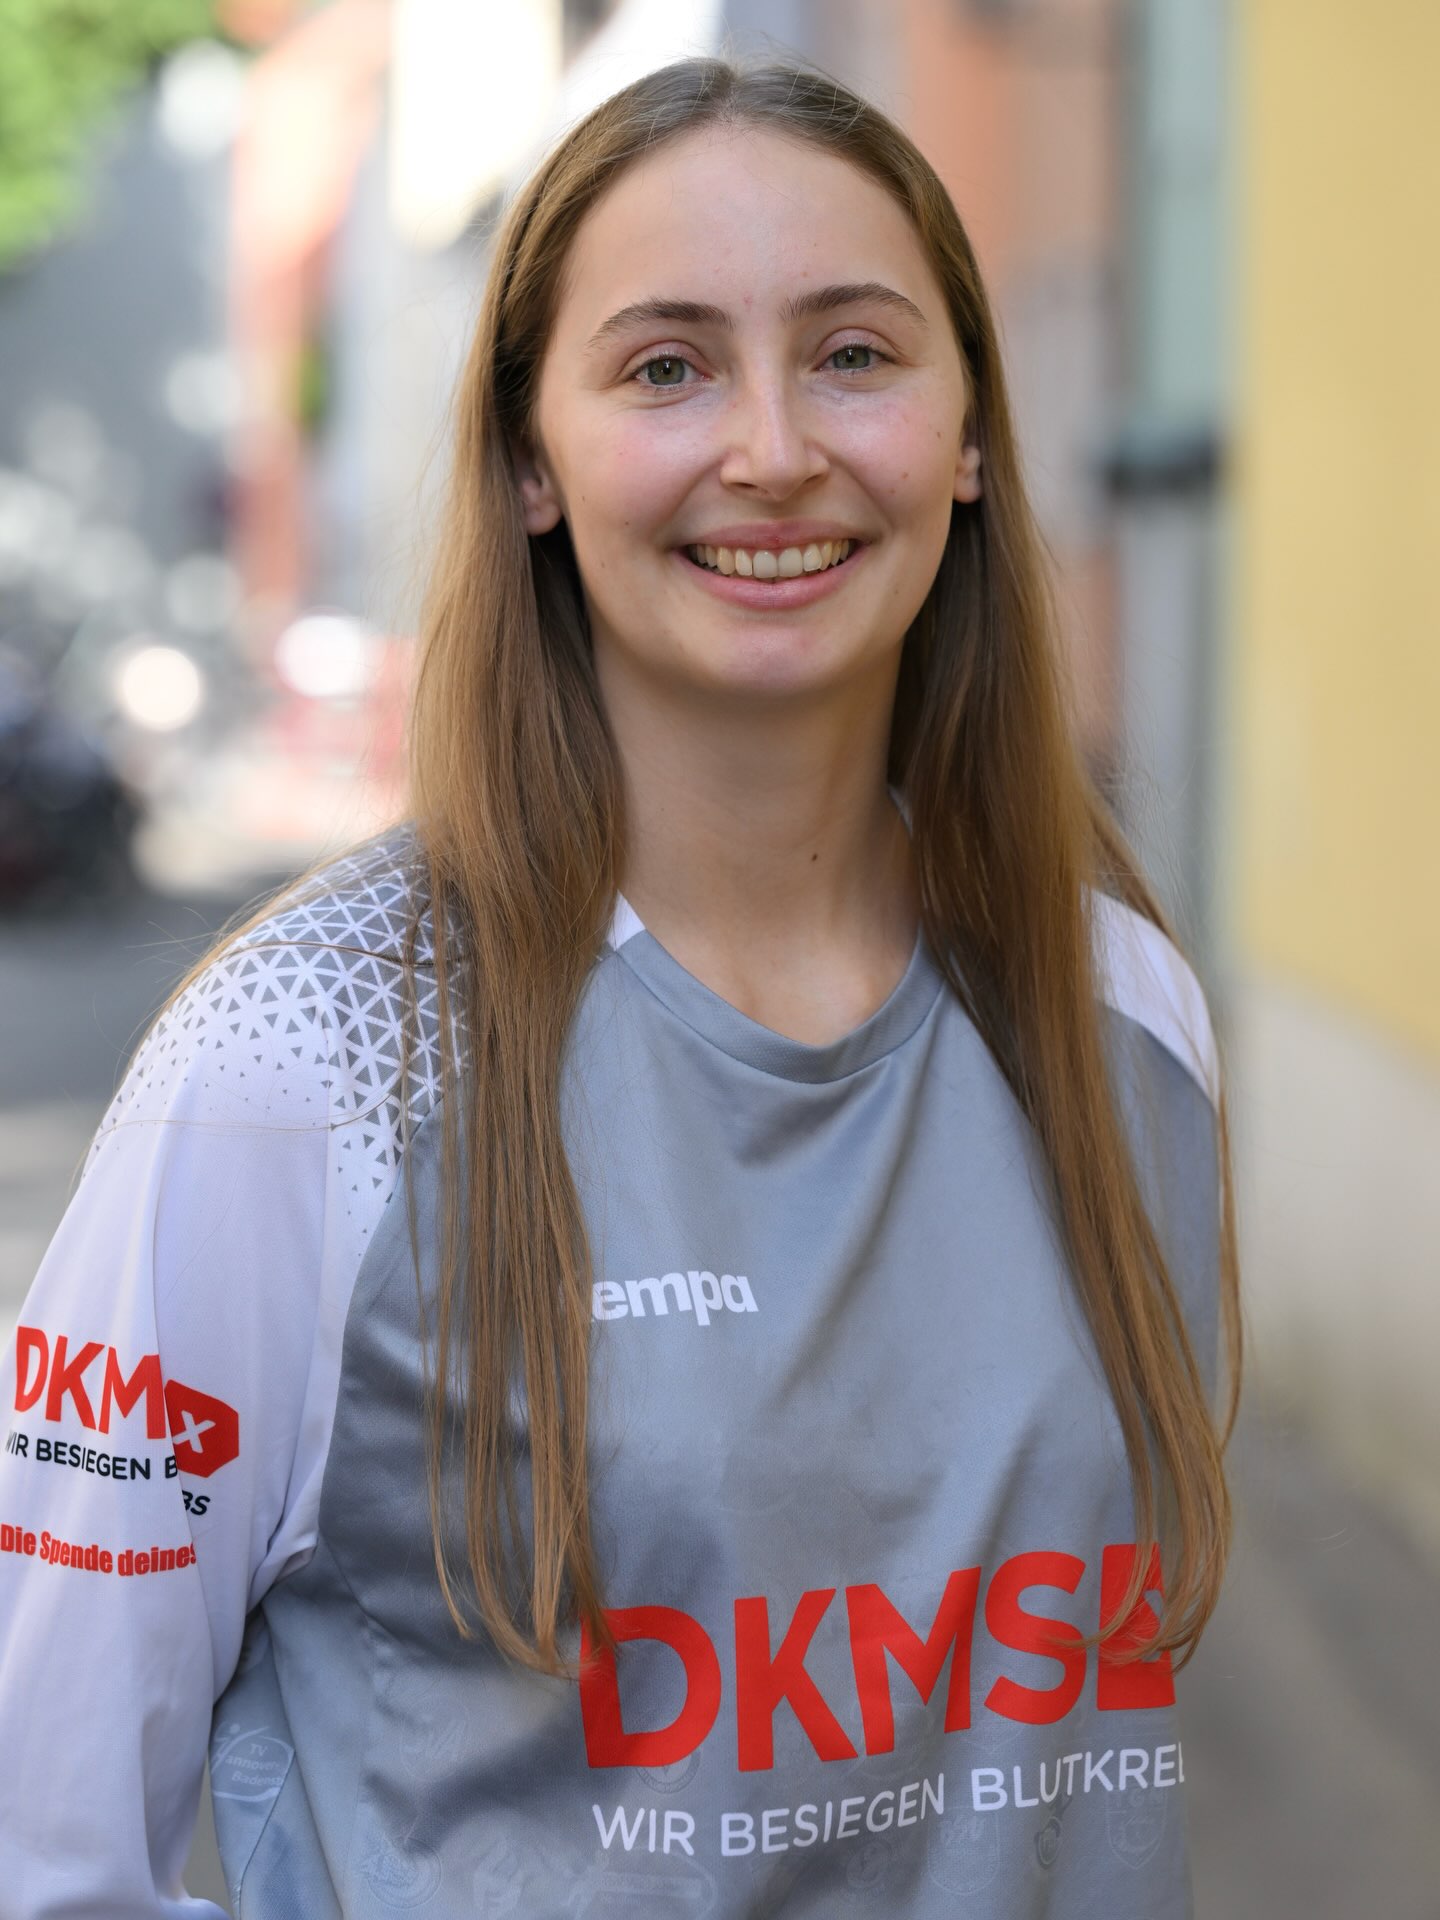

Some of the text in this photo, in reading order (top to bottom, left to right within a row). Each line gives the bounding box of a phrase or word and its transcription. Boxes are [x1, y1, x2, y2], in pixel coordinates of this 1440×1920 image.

[591, 1270, 759, 1326] empa
[36, 1438, 151, 1481] BESIEGEN
[1, 1523, 37, 1556] Die
[40, 1530, 113, 1574] Spende
[579, 1551, 1088, 1772] DKMS
[592, 1804, 695, 1857] WIR
[720, 1772, 945, 1857] BESIEGEN
